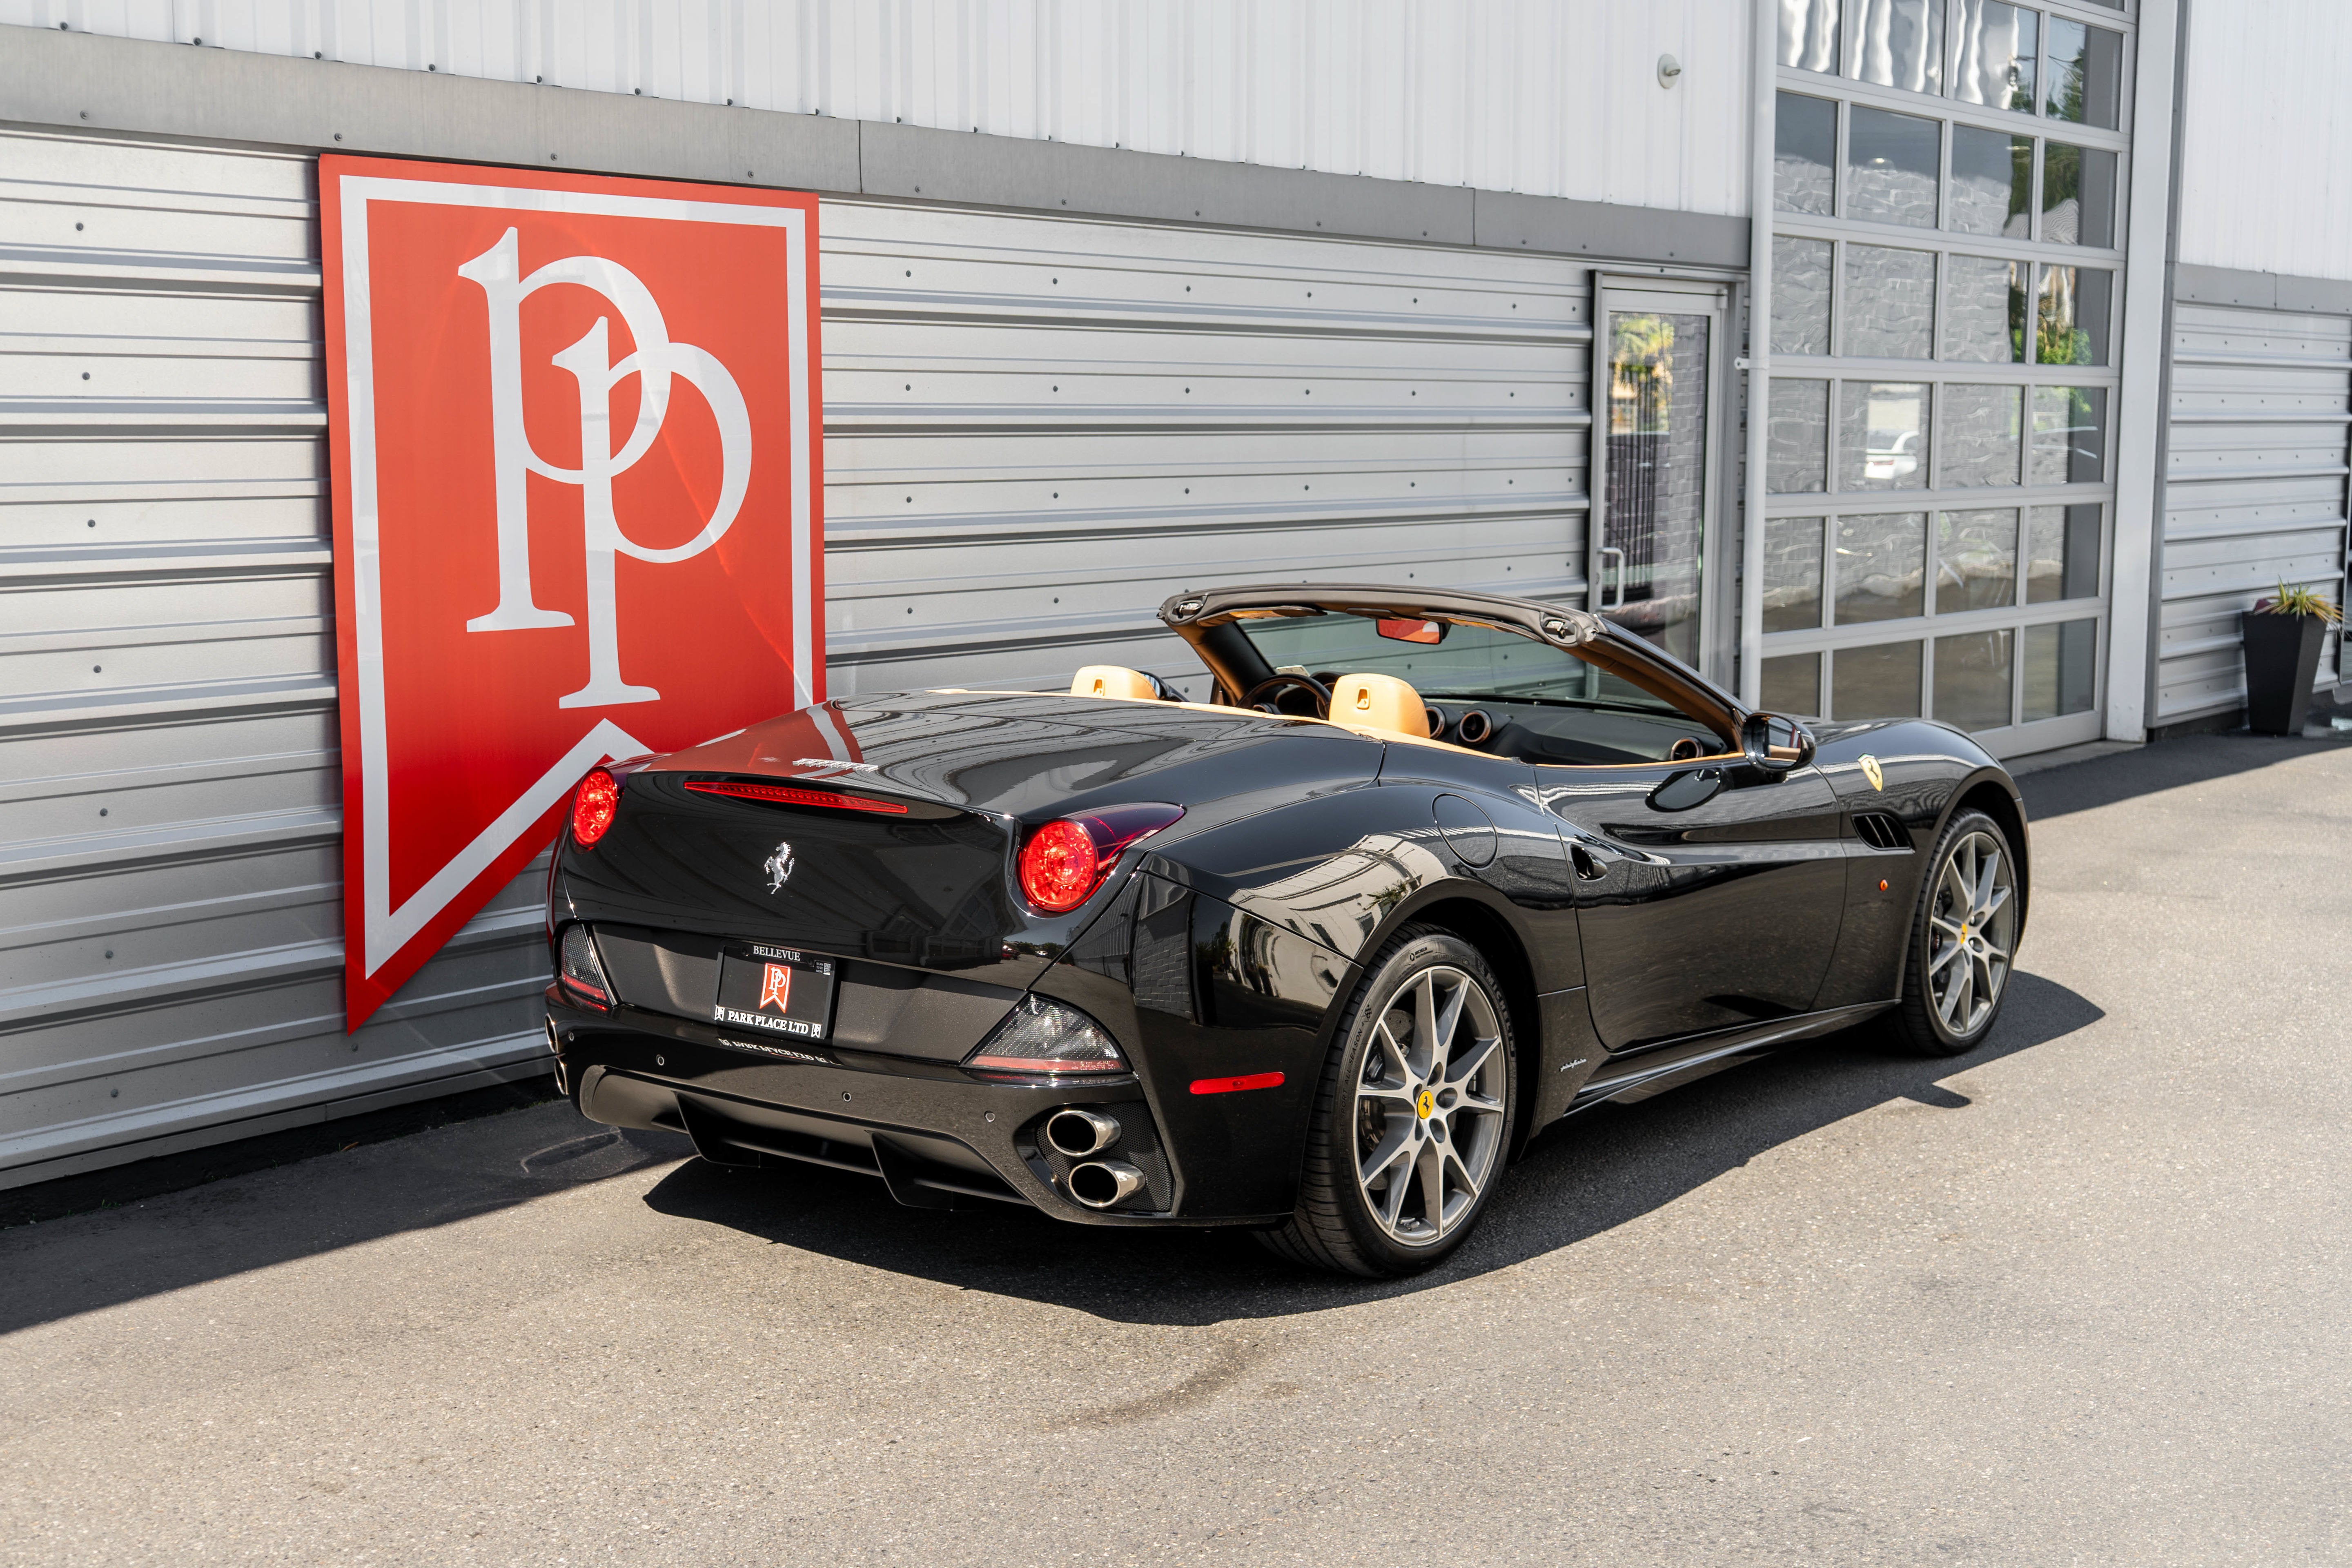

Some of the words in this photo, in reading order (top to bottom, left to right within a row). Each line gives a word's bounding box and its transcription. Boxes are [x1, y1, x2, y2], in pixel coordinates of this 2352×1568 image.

[753, 945, 800, 961] BELLEVUE
[727, 1010, 755, 1025] PARK
[755, 1015, 787, 1031] PLACE
[787, 1021, 809, 1034] LTD
[1348, 1029, 1363, 1066] SEASON
